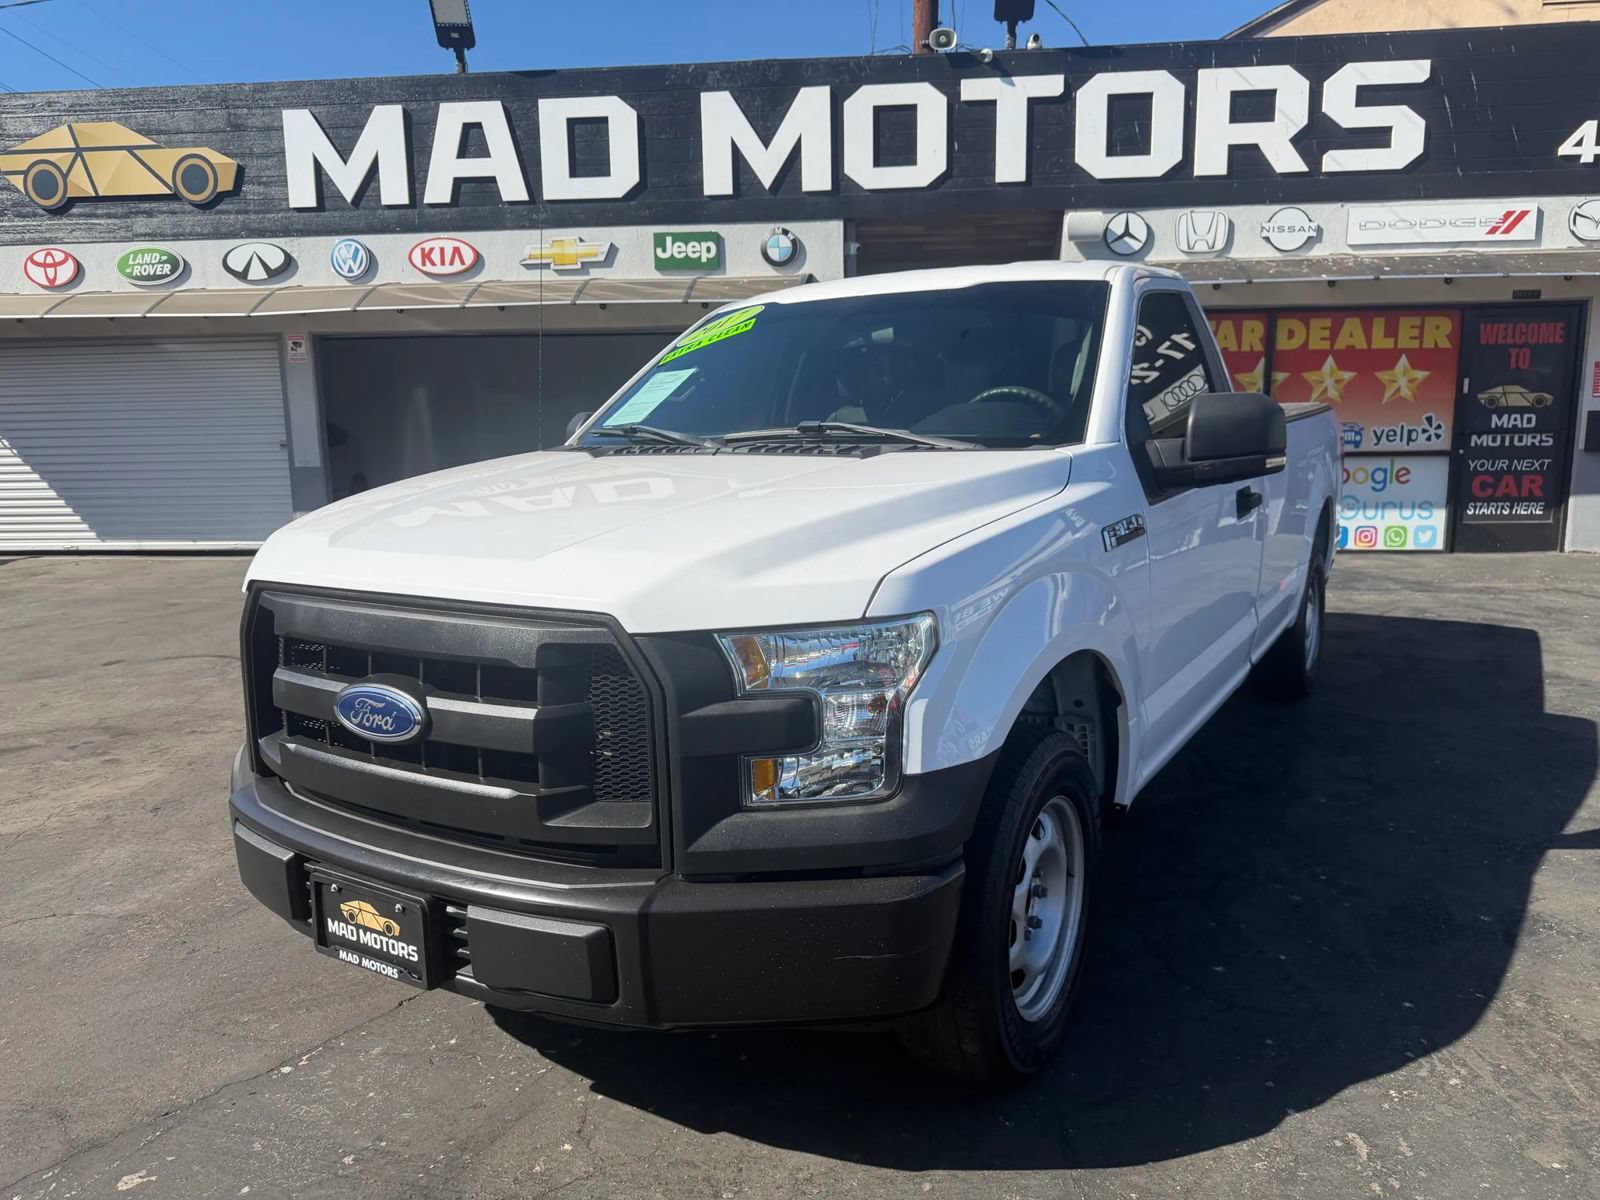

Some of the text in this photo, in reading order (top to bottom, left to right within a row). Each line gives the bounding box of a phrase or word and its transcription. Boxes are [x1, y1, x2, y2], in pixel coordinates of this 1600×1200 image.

[282, 59, 1432, 209] MAD MOTORS
[1261, 225, 1317, 233] NISSAN
[1359, 216, 1506, 231] DODGE
[129, 253, 160, 264] LAND
[420, 246, 466, 267] KIA
[656, 236, 717, 262] Jeep
[133, 264, 171, 276] ROVER
[1211, 316, 1453, 351] AR DEALER
[1480, 322, 1565, 345] WELCOME
[1509, 348, 1531, 369] TO
[1491, 413, 1537, 428] MAD
[1372, 424, 1419, 447] yelp
[1470, 434, 1554, 447] MOTORS
[1468, 459, 1552, 471] YOUR NEXT
[1472, 474, 1544, 497] CAR
[1466, 502, 1545, 515] STARTS HERE
[350, 697, 396, 731] Ford
[327, 917, 419, 962] MAD MOTORS
[339, 949, 399, 979] MAD MOTORS
